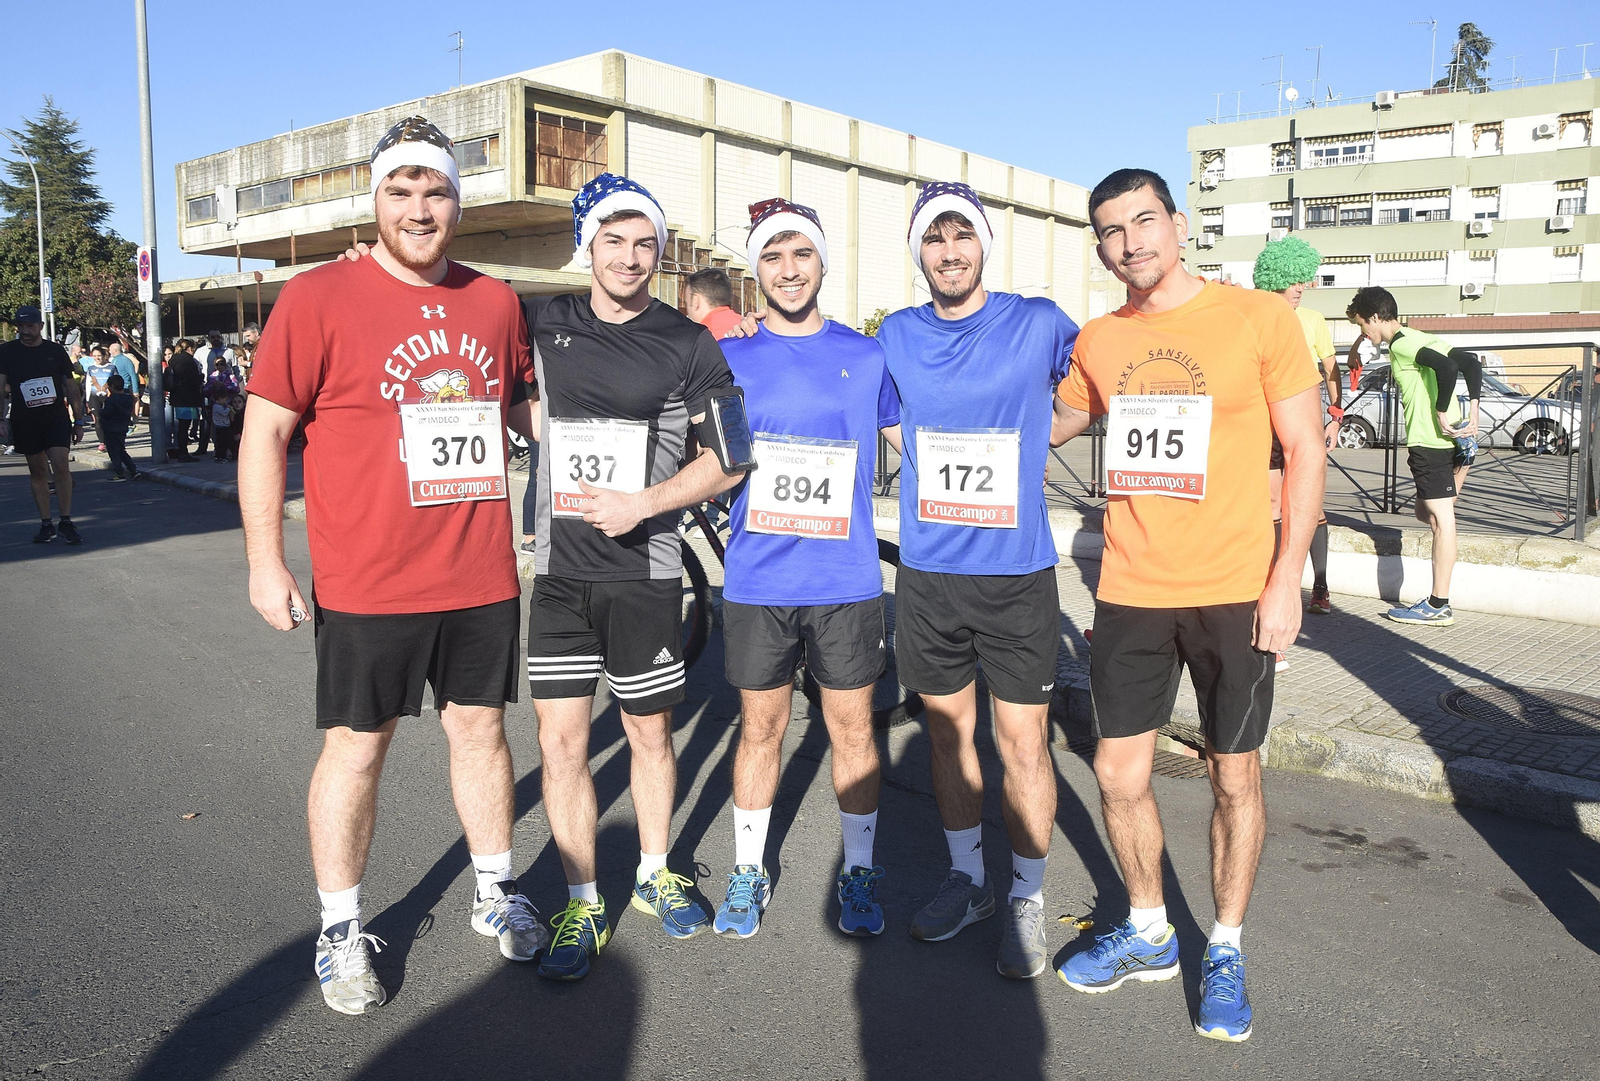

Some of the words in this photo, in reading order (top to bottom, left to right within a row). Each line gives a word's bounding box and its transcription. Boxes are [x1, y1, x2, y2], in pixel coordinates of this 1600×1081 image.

[380, 329, 449, 401] SETON
[459, 333, 500, 394] HILL
[29, 386, 50, 397] 350
[428, 415, 460, 424] IMDECO
[1127, 407, 1157, 415] IMDECO
[431, 435, 486, 467] 370
[936, 444, 966, 453] IMDECO
[1126, 428, 1184, 459] 915
[568, 453, 618, 483] 337
[939, 463, 994, 492] 172
[419, 481, 491, 497] Cruzcampo
[773, 474, 831, 505] 894
[1113, 471, 1186, 490] Cruzcampo
[757, 511, 832, 533] Cruzcampo
[926, 501, 997, 522] Cruzcampo
